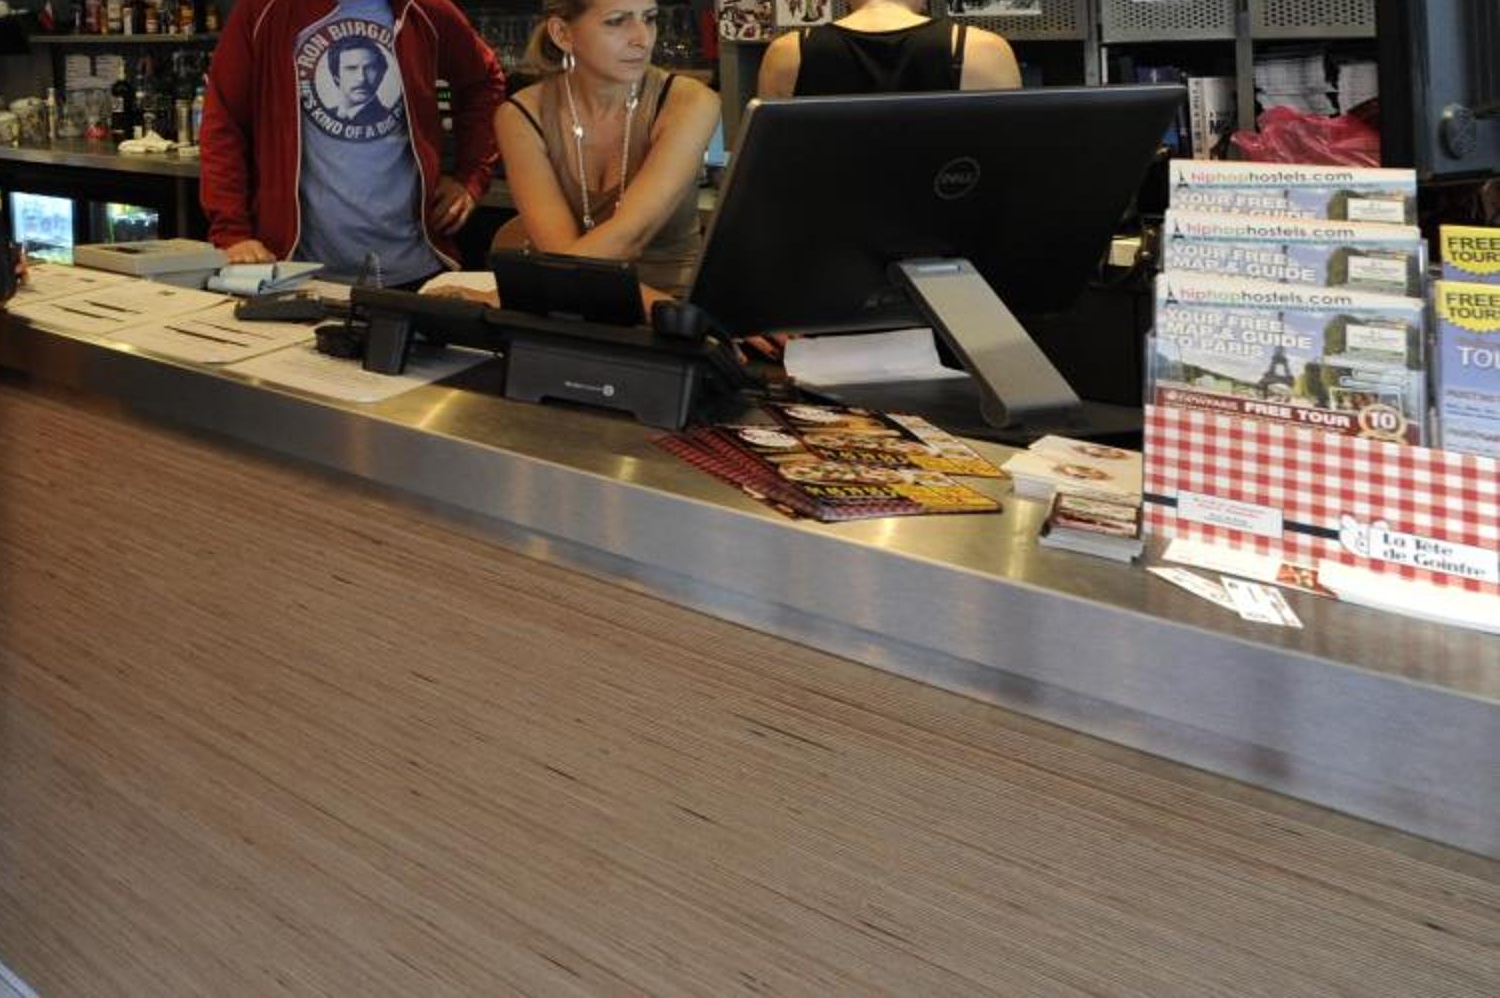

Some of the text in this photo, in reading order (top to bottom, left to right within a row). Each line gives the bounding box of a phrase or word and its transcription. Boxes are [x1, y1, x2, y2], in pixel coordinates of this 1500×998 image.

[298, 36, 329, 68] RON
[311, 107, 343, 135] KIND
[344, 125, 364, 139] OF
[365, 126, 376, 139] A
[1190, 169, 1354, 184] hiphophostels.com
[1186, 224, 1355, 239] hiphophostels.com
[1447, 236, 1500, 252] FREE
[1248, 261, 1317, 281] GUIDE
[1179, 288, 1353, 306] hiphophostels.com
[1445, 292, 1500, 308] FREE
[1243, 329, 1314, 350] GUIDE
[1244, 401, 1350, 428] FREE TOUR
[1369, 411, 1396, 431] 10
[1383, 532, 1406, 548] La
[1382, 548, 1407, 561] de
